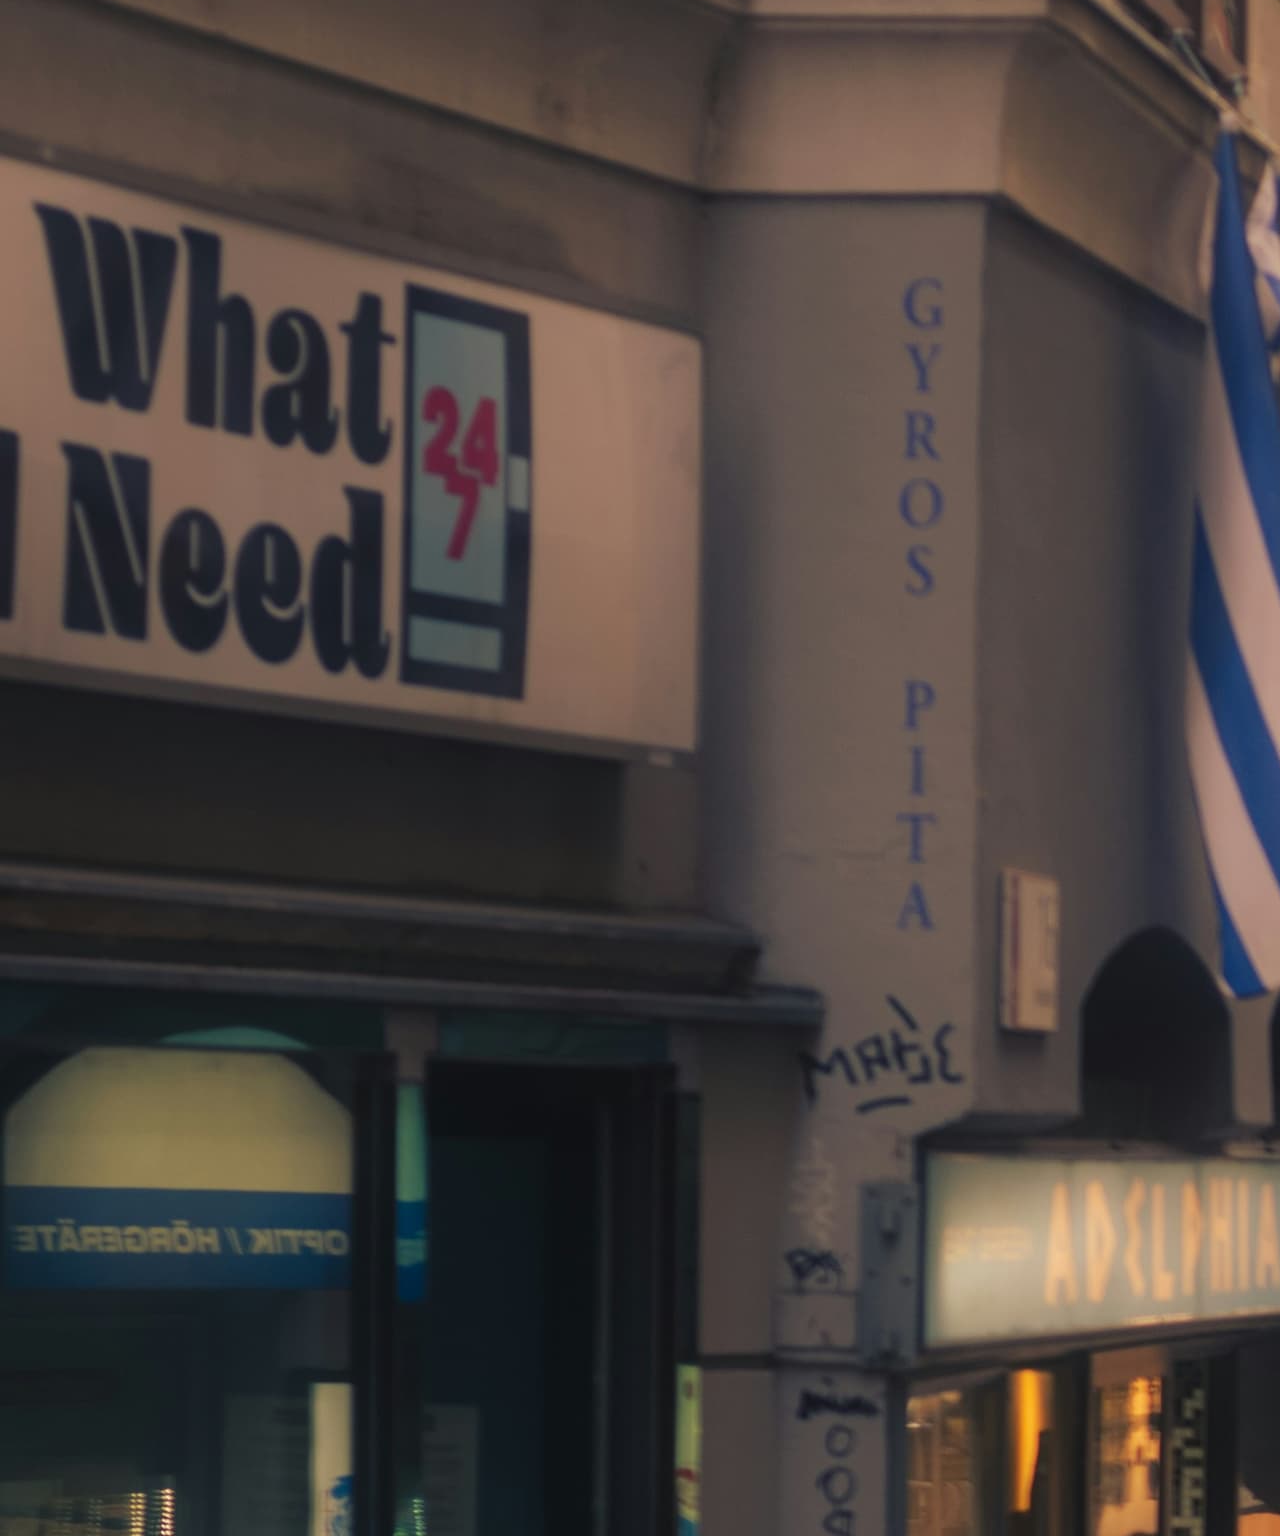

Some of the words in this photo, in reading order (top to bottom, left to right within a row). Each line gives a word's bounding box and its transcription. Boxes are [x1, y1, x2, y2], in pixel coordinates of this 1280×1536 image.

[33, 202, 397, 466] What
[422, 386, 499, 487] 24
[899, 277, 944, 598] GYROS
[61, 440, 393, 681] Need
[444, 478, 481, 562] 7
[896, 679, 941, 932] PITA
